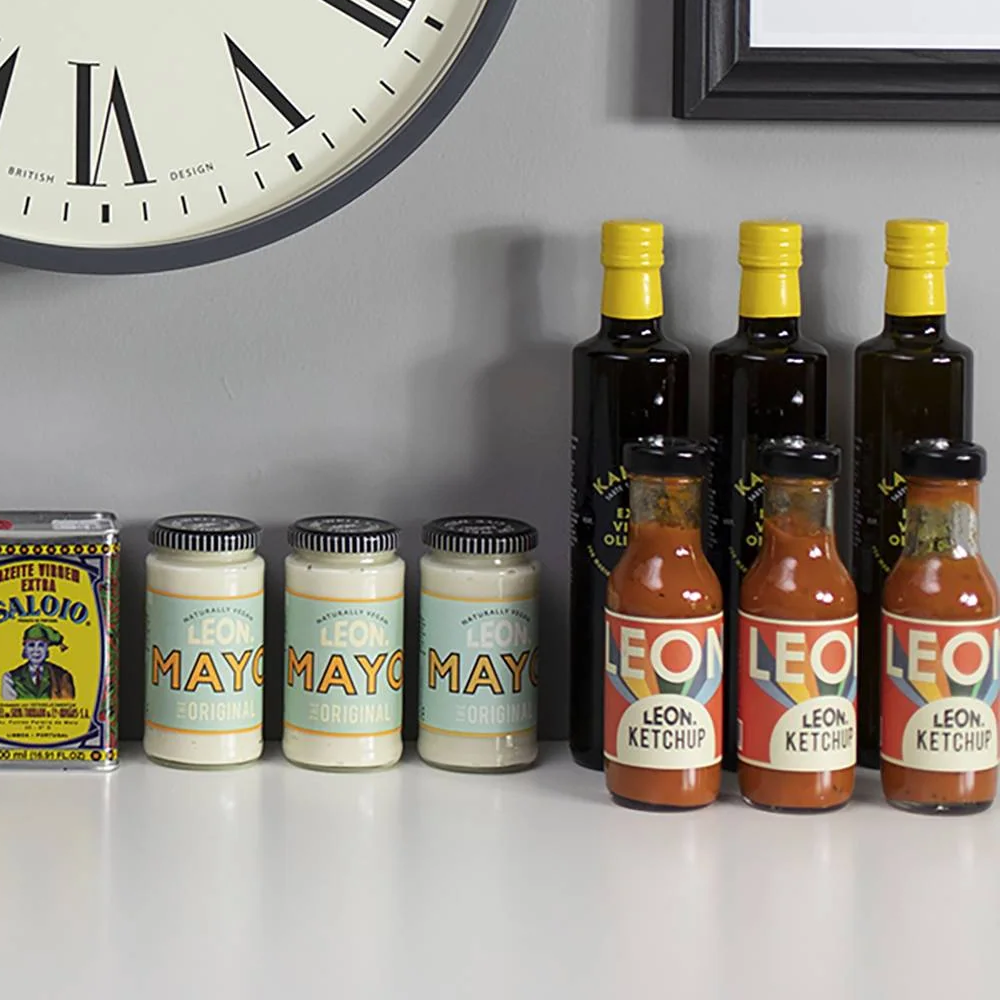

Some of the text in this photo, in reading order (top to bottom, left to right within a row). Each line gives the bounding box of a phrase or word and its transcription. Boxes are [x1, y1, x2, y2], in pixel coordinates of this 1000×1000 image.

[225, 33, 316, 156] V
[7, 161, 215, 184] BRITISH DESIGN
[604, 534, 627, 546] OLI
[183, 607, 231, 622] NATURALLY
[316, 609, 364, 624] NATURALLY
[461, 608, 509, 625] NATURALLY
[749, 625, 858, 685] LEO
[287, 645, 404, 696] MAYO
[188, 701, 256, 721] ORIGINAL
[320, 703, 392, 724] ORIGINAL
[467, 701, 533, 725] ORIGINAL
[643, 706, 697, 726] LEON.
[802, 707, 849, 728] LEON.
[933, 708, 985, 729] LEON.
[628, 726, 706, 749] KETCHUP
[916, 729, 992, 753] KETCHUP
